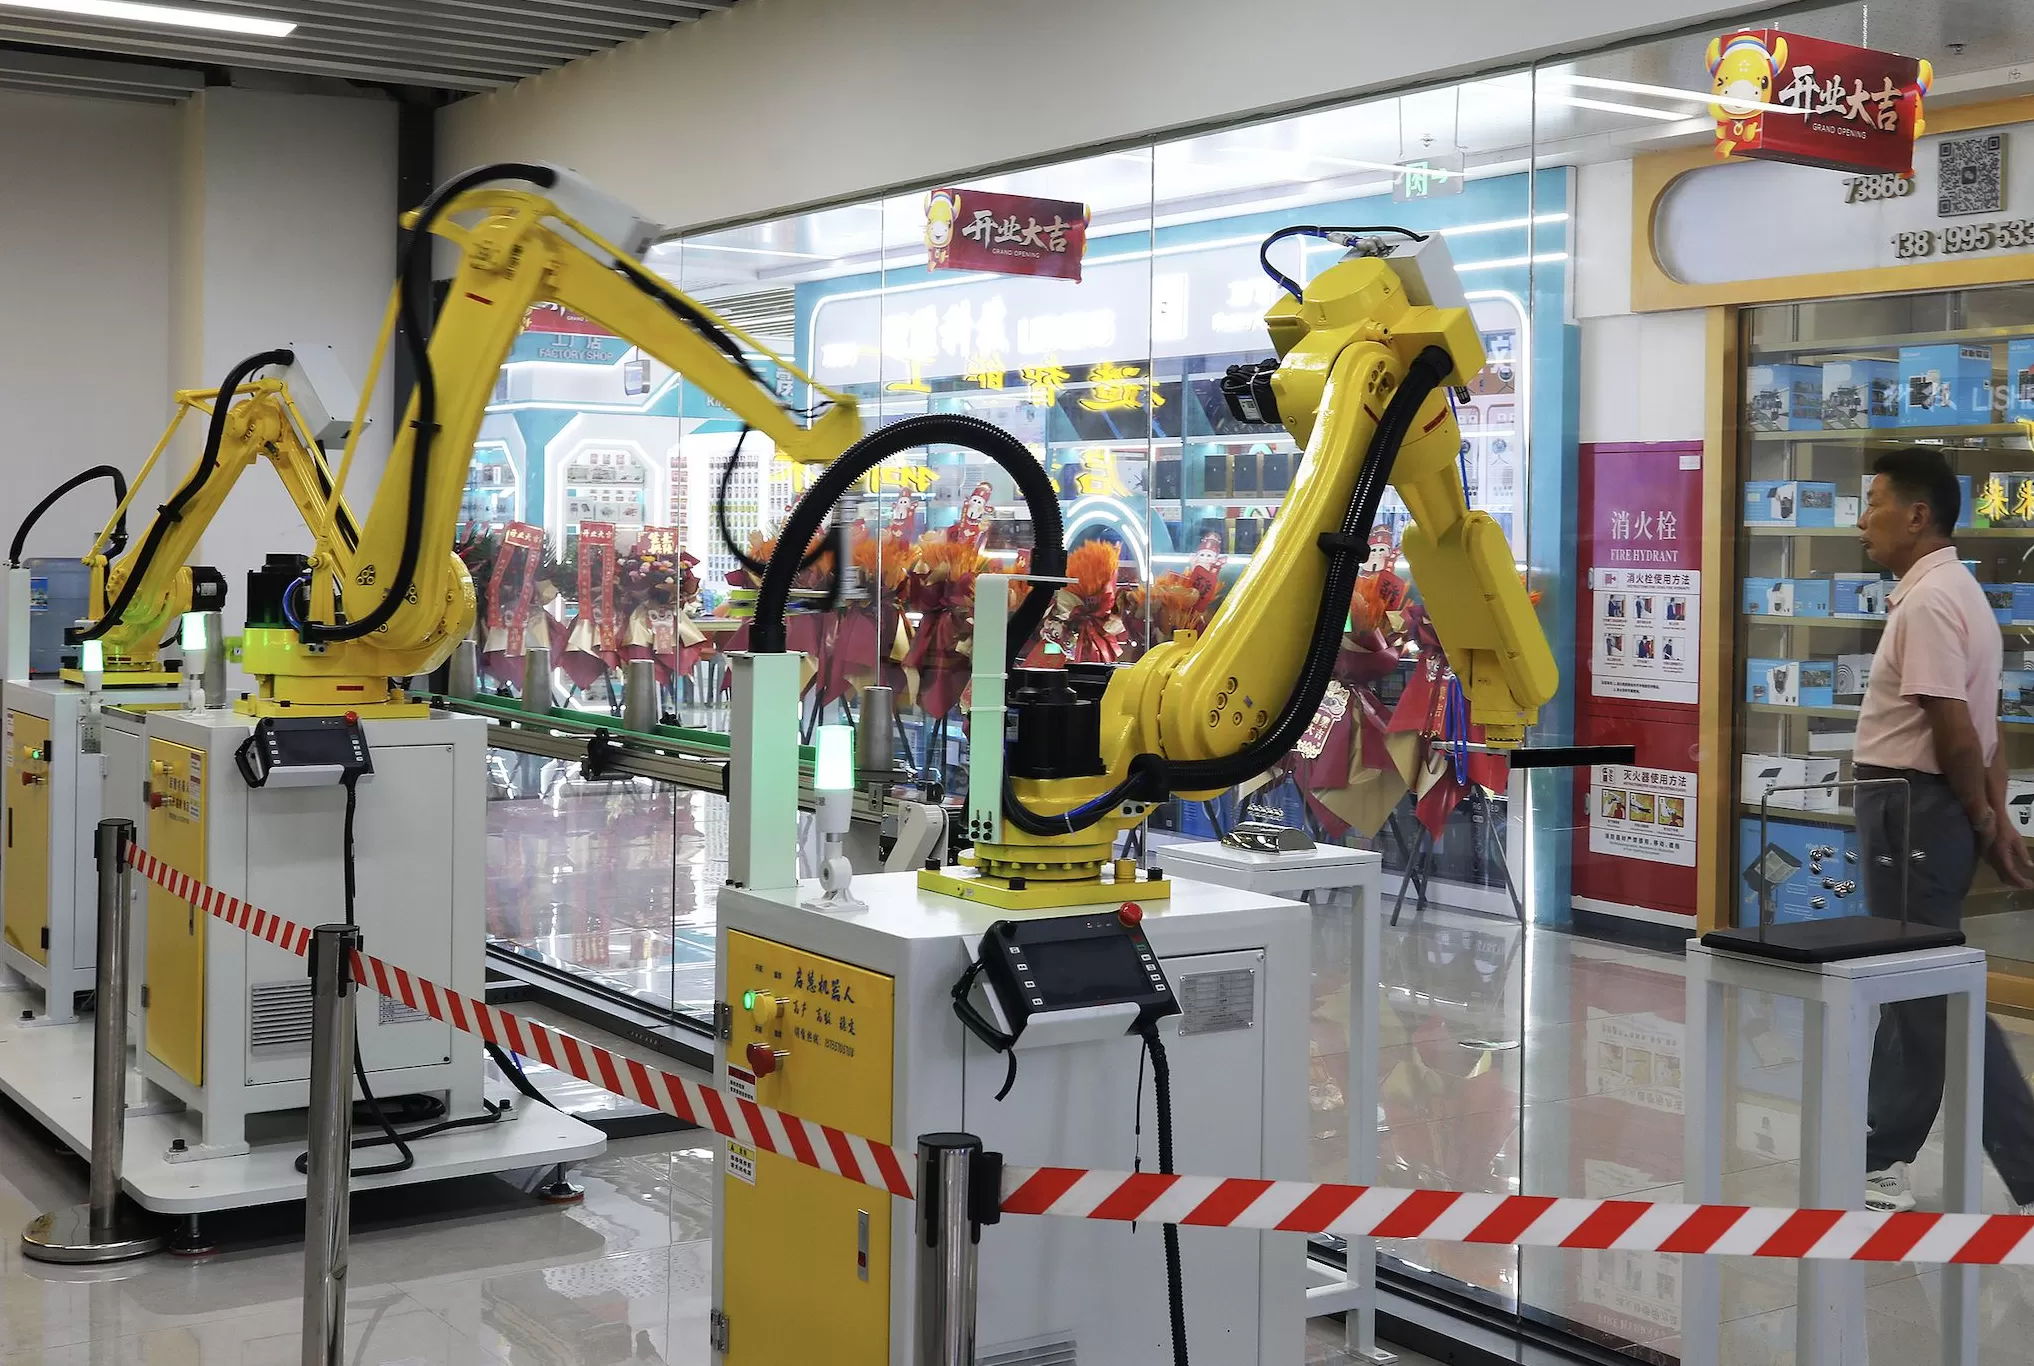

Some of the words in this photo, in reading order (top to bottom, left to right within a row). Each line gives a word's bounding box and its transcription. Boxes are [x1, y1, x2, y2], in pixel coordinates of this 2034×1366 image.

[1778, 64, 1904, 133] 开业大吉
[1812, 122, 1836, 136] GRAND
[1837, 126, 1867, 140] OPENING
[961, 209, 1072, 253] 开业大吉
[1891, 230, 1932, 259] 138
[1938, 222, 1994, 253] 1995
[991, 247, 1012, 258] GRAND
[1013, 249, 1041, 260] OPENING
[538, 347, 584, 361] FACTORY
[586, 349, 614, 362] SHOP
[1610, 510, 1678, 541] 消火栓
[1610, 548, 1632, 562] FIRE
[1633, 549, 1679, 563] HYDRANT
[1626, 572, 1691, 586] 消火栓使用方法
[1623, 768, 1687, 787] 灭火器使用方法
[794, 966, 855, 1004] 启慧机器人
